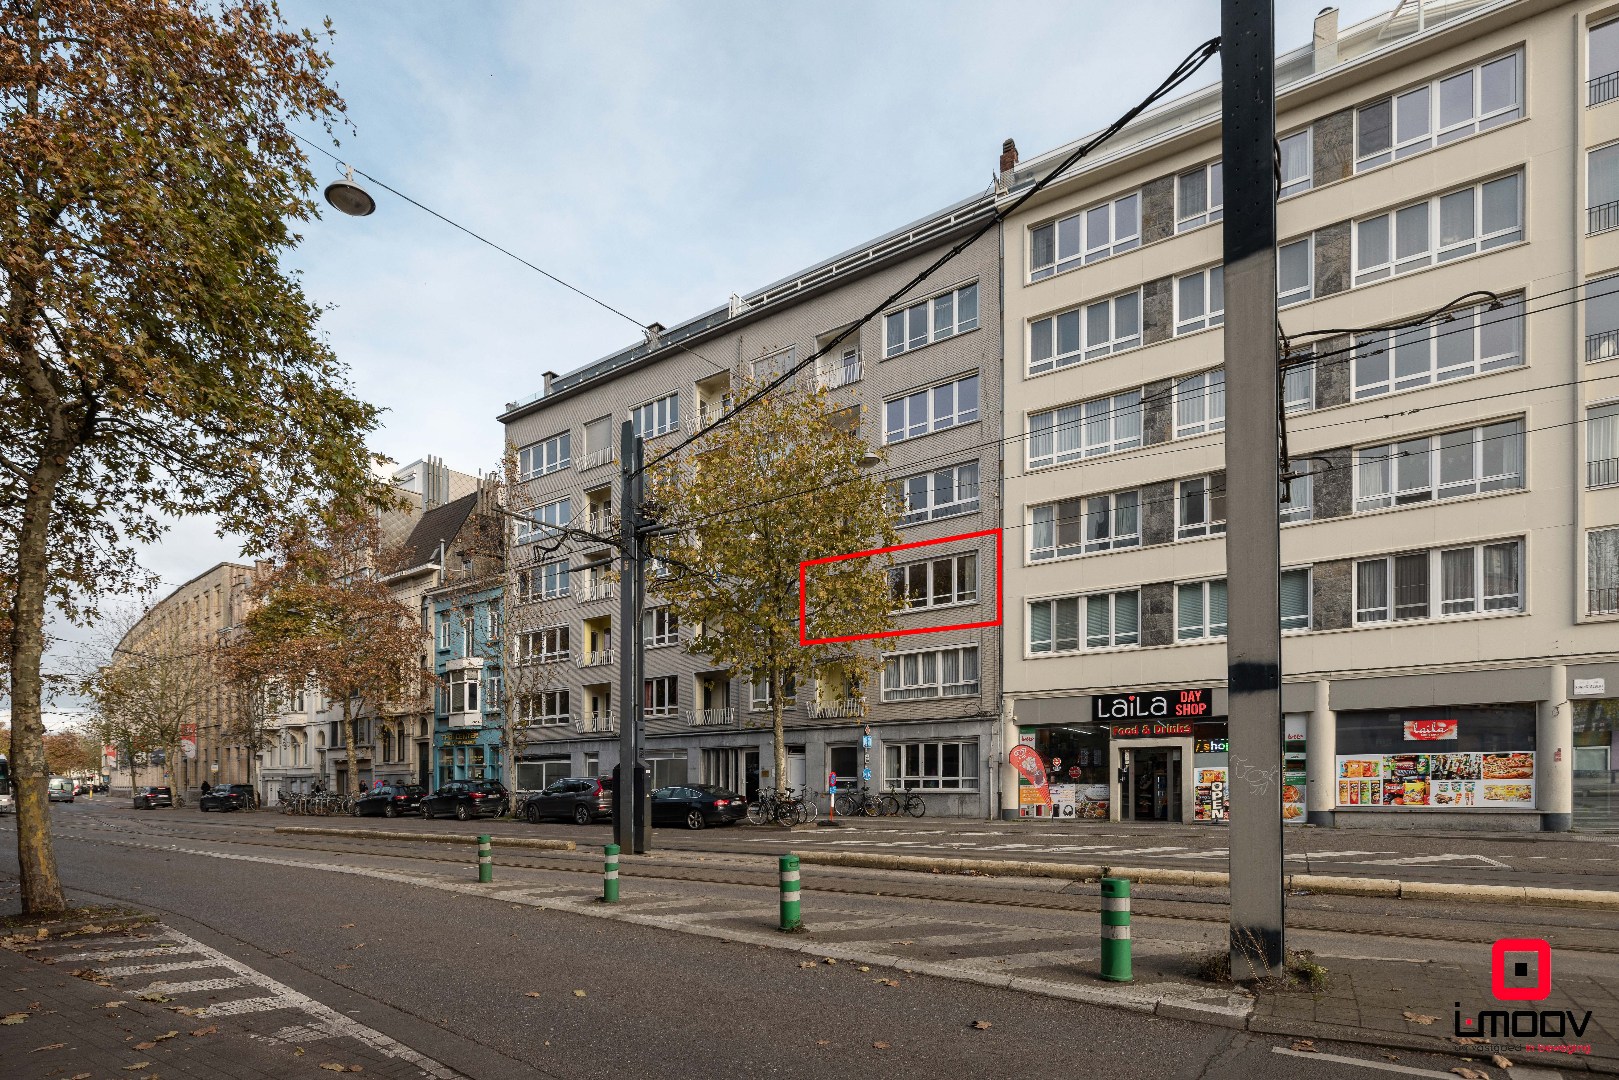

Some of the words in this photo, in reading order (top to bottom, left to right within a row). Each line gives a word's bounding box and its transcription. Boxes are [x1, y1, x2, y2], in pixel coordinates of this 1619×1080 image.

[1180, 690, 1202, 703] DAY
[1175, 703, 1207, 716] SHOP
[1113, 725, 1139, 736] Food
[1142, 724, 1151, 735] &
[1154, 723, 1192, 734] Drinks
[1211, 781, 1224, 819] OPEN
